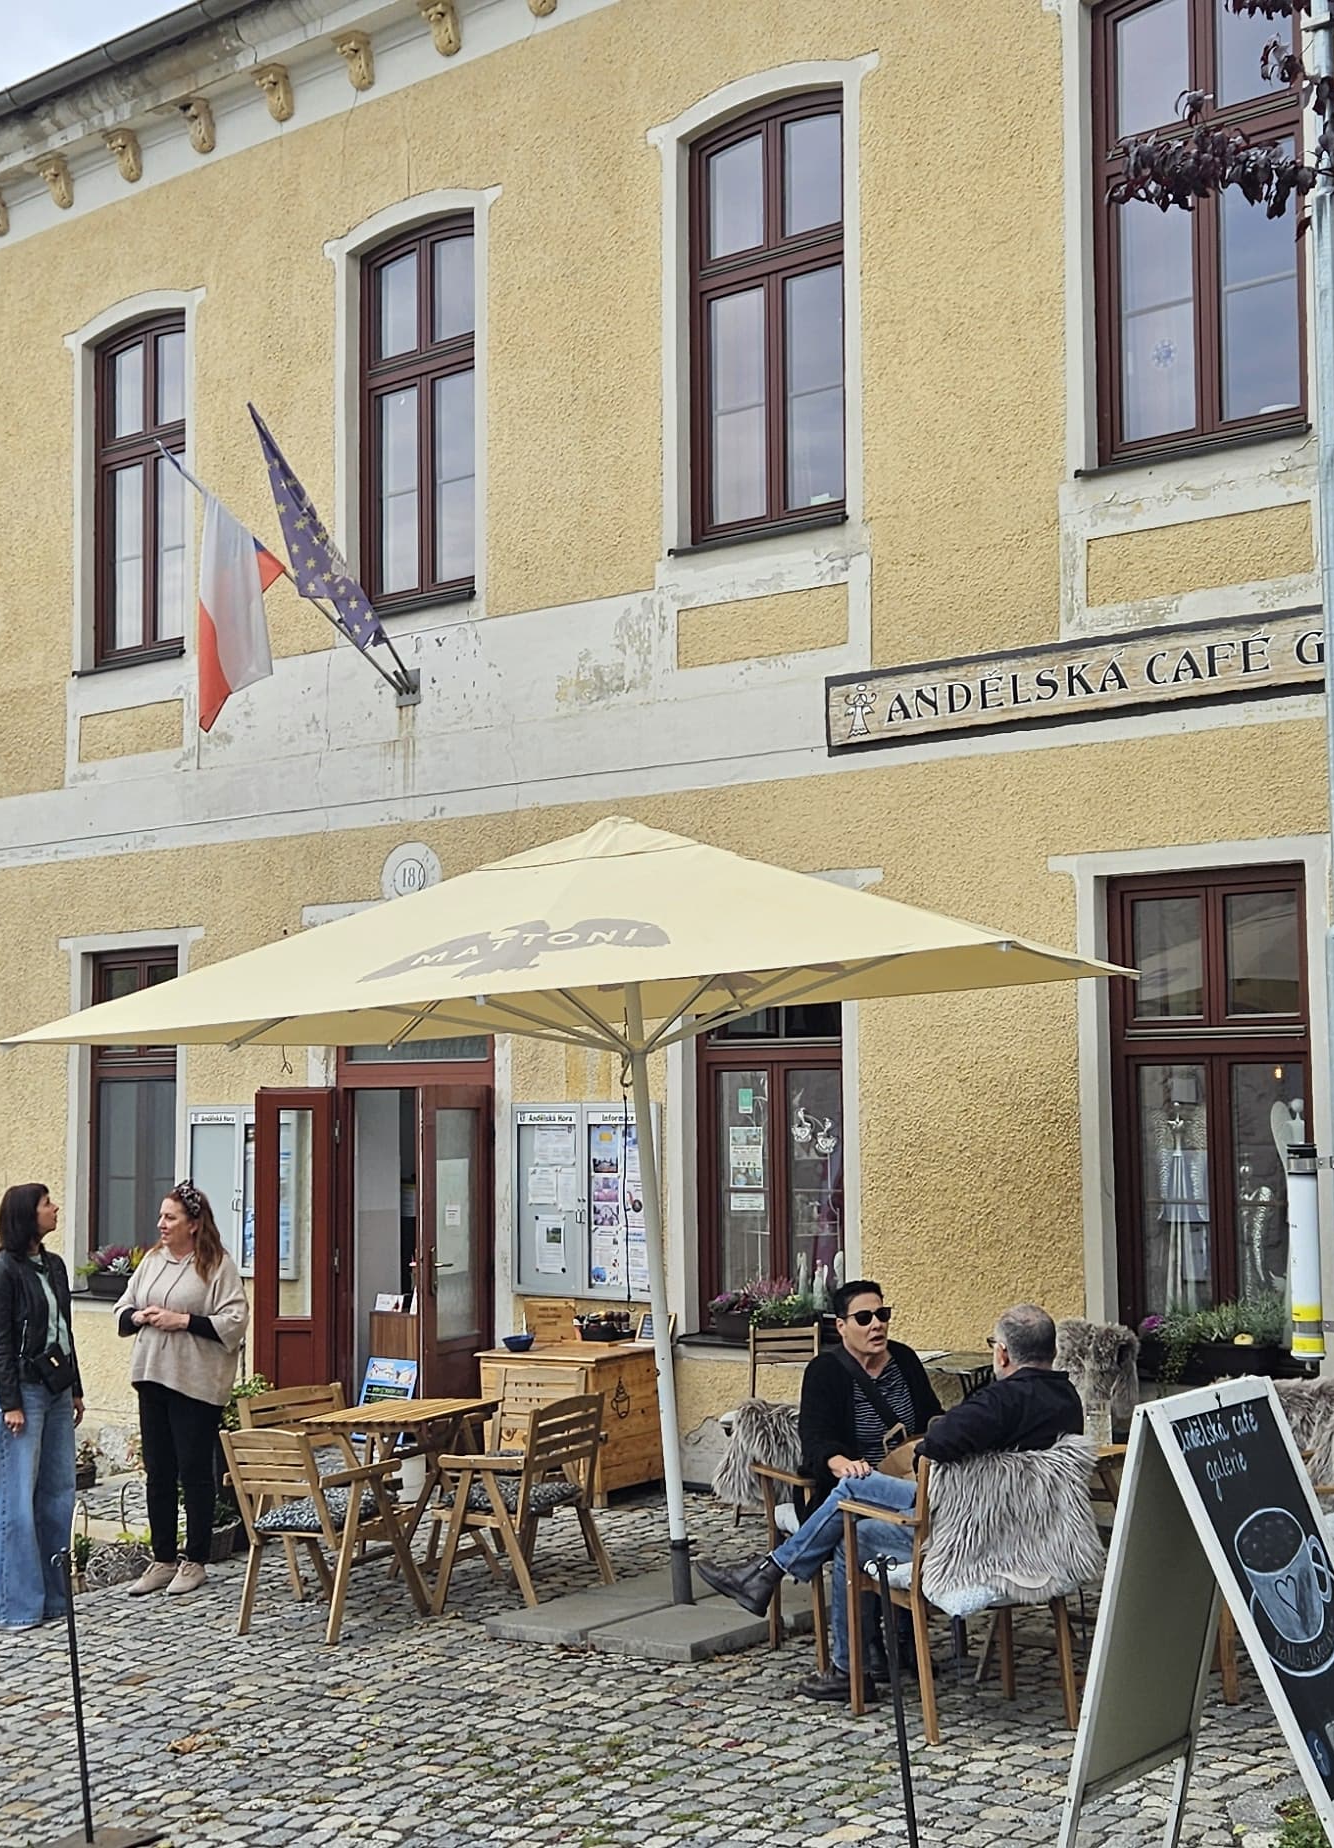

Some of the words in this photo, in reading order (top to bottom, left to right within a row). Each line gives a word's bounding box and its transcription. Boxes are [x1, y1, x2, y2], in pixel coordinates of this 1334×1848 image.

[884, 648, 1129, 726] ANDĚLSKÁ
[1144, 628, 1272, 686] CAFÉ
[410, 927, 639, 967] MATTONI
[1232, 1403, 1259, 1437] café
[1205, 1447, 1247, 1502] galerie
